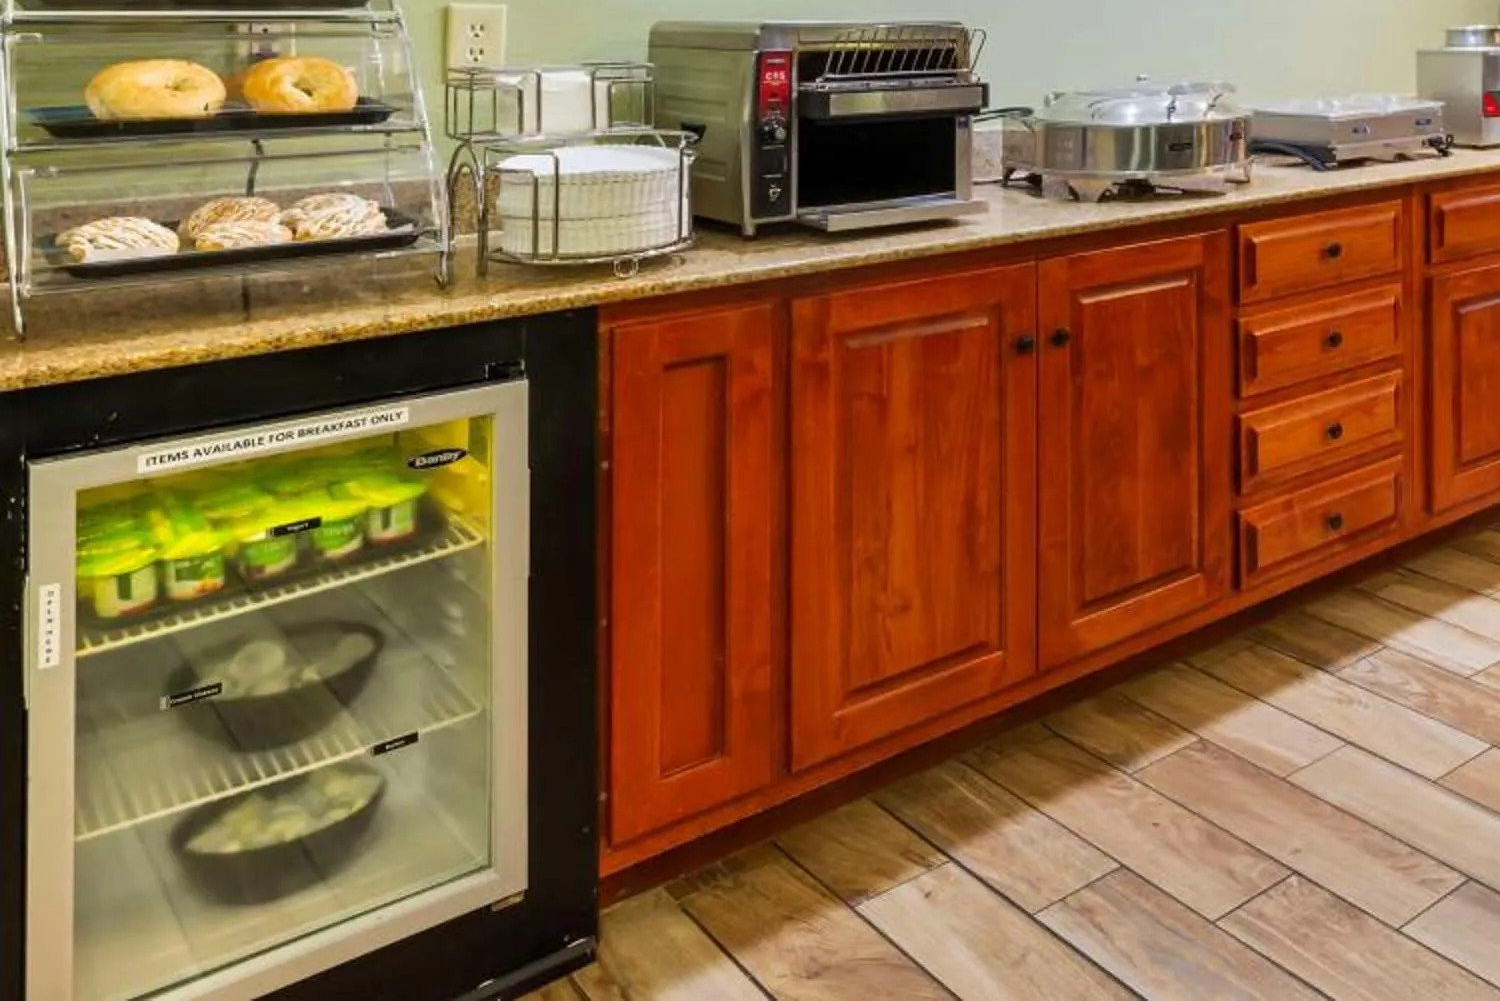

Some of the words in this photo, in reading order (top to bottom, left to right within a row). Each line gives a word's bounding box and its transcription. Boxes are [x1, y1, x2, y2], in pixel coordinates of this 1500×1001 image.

[145, 449, 190, 467] ITEMS
[193, 435, 266, 457] AVAILABLE
[268, 430, 295, 444] FOR
[297, 417, 367, 438] BREAKFAST
[370, 410, 403, 425] ONLY
